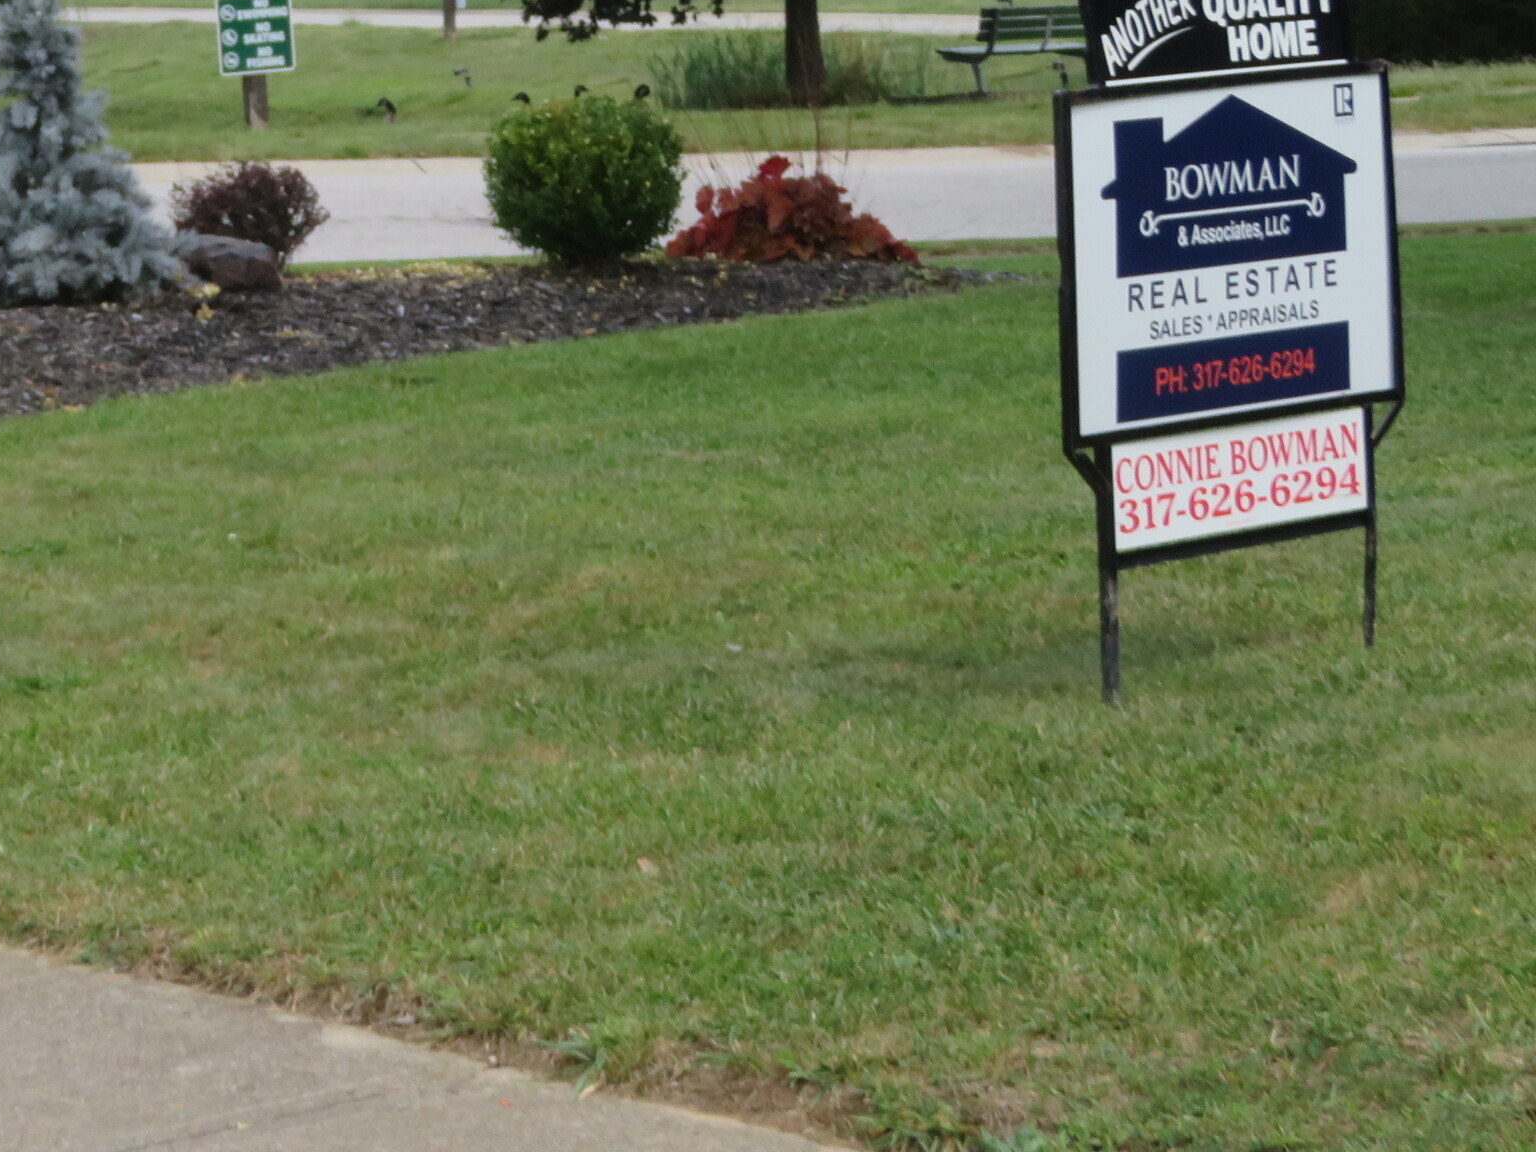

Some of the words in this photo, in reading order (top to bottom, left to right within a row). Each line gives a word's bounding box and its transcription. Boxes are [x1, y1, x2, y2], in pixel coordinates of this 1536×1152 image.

[1227, 20, 1320, 62] HOME
[1164, 154, 1300, 201] BOWMAN
[1177, 225, 1189, 248] &
[1191, 219, 1264, 245] Associates,
[1265, 214, 1291, 237] LLC
[1128, 276, 1208, 313] REAL
[1225, 259, 1338, 300] ESTATE
[1149, 313, 1203, 340] SALES
[1215, 299, 1320, 332] APPRAISALS
[1154, 365, 1187, 396] PH:
[1192, 347, 1316, 391] 317-626-6294
[1115, 446, 1222, 494] CONNIE
[1231, 421, 1359, 476] BOWMAN
[1119, 463, 1361, 534] 317-626-6294
